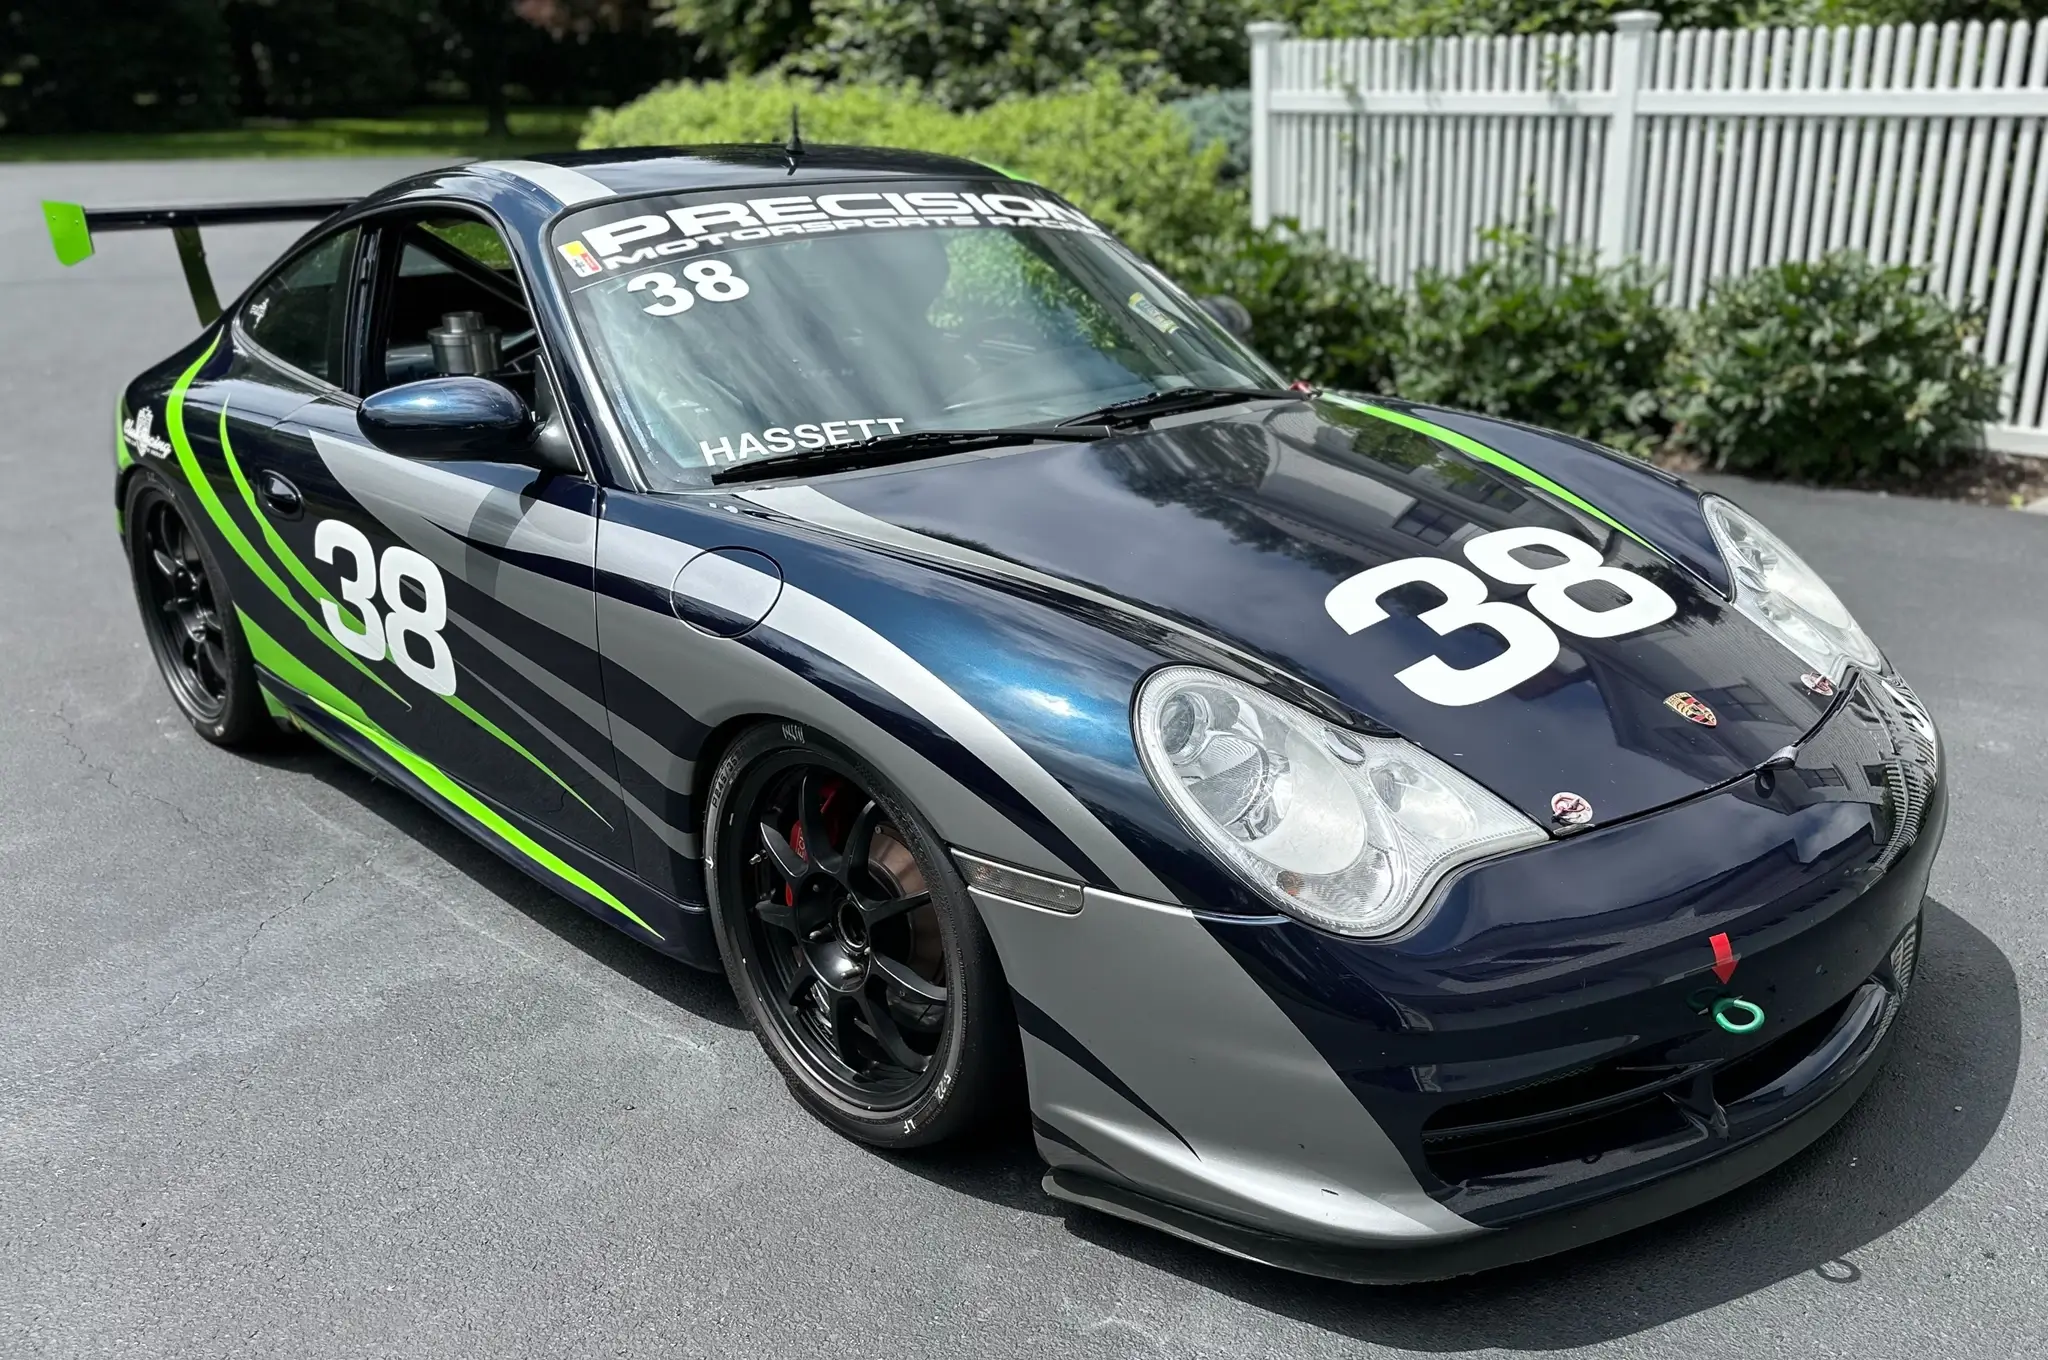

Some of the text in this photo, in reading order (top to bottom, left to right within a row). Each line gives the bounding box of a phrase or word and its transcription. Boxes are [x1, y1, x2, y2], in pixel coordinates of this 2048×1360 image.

[582, 192, 1101, 257] PRECISION
[601, 216, 980, 270] MOTORSPORTS
[627, 260, 749, 316] 38
[699, 418, 904, 466] HASSETT
[314, 519, 456, 696] 38
[1325, 526, 1677, 706] 38
